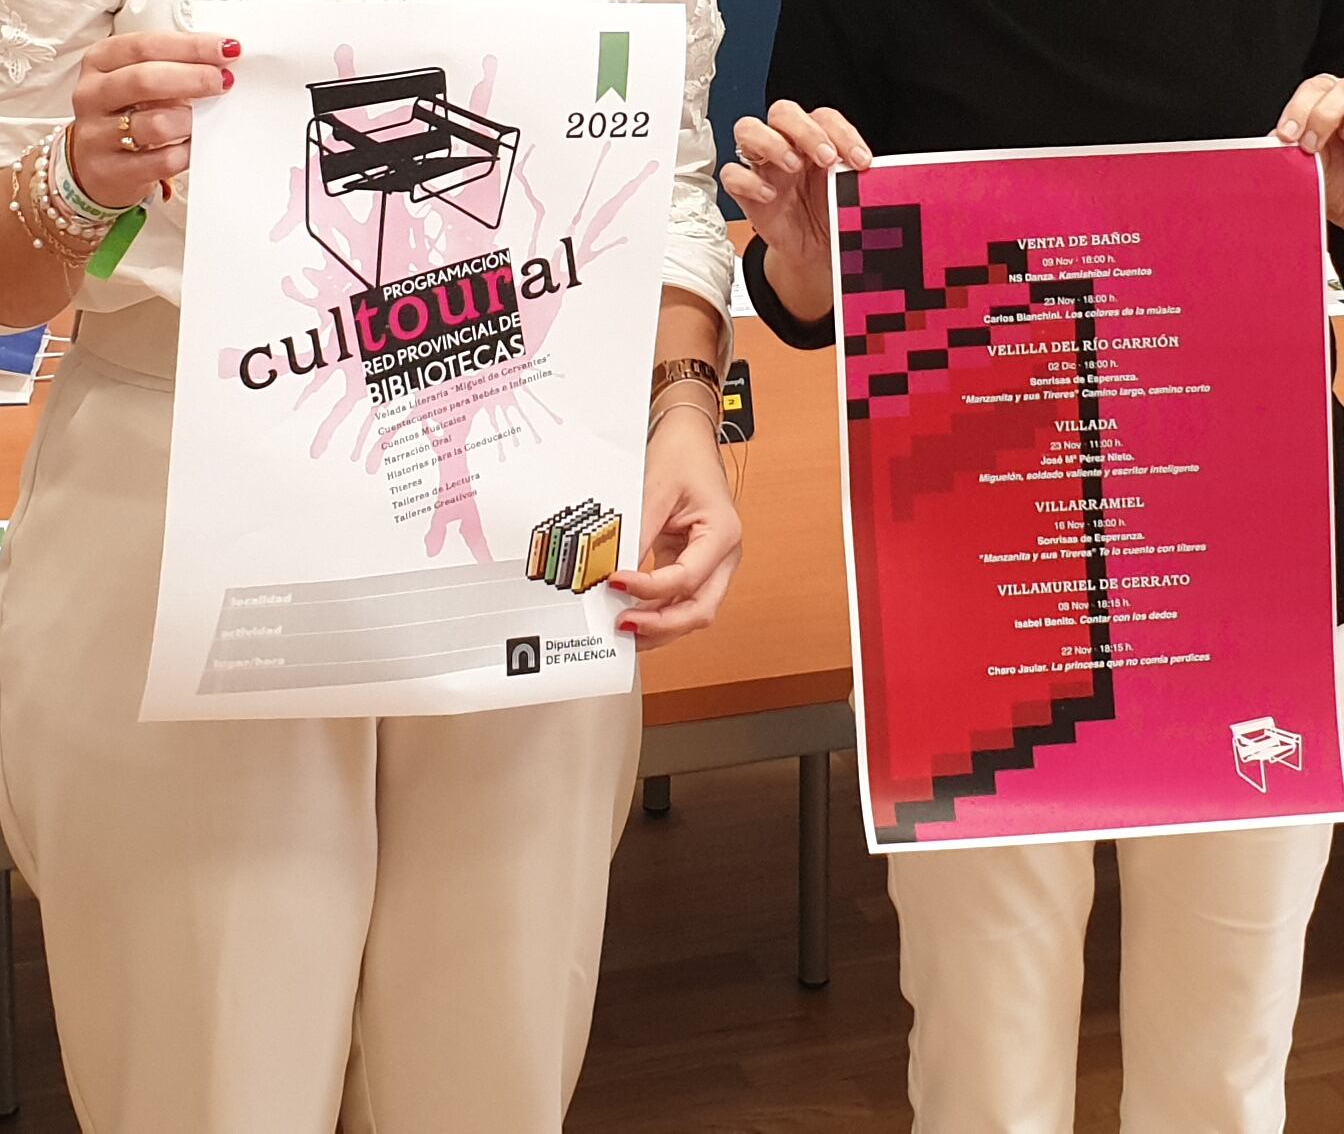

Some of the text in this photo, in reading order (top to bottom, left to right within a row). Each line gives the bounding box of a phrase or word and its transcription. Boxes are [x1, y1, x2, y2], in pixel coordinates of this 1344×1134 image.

[566, 112, 650, 139] 2022
[1018, 232, 1141, 250] VENTA DE BAÑOS
[383, 248, 512, 301] PROGRAMACIÓN
[362, 311, 522, 379] RED PROVINCIAL DE
[988, 342, 1048, 356] VELILLA
[1052, 342, 1076, 354] DEL
[1083, 337, 1108, 352] RÍO
[366, 333, 526, 406] BIBLIOTECAS
[374, 404, 407, 421] Velada
[408, 390, 449, 409] Literaria
[488, 373, 500, 385] de
[1055, 418, 1118, 432] VILLADA
[381, 431, 420, 451] Cuentos
[384, 434, 452, 466] Narración Oral
[386, 458, 430, 481] Historias
[432, 452, 452, 466] para
[464, 425, 522, 452] Coeducación
[392, 491, 430, 510] Talleres
[446, 472, 480, 490] Lectura
[1035, 496, 1145, 513] VILLARRAMIEL
[394, 490, 478, 524] Talleres Creativos
[997, 578, 1096, 596] VILLAMURIEL
[1100, 578, 1118, 590] DE
[546, 636, 603, 652] Diputación
[546, 648, 616, 665] DE PALENCIA
